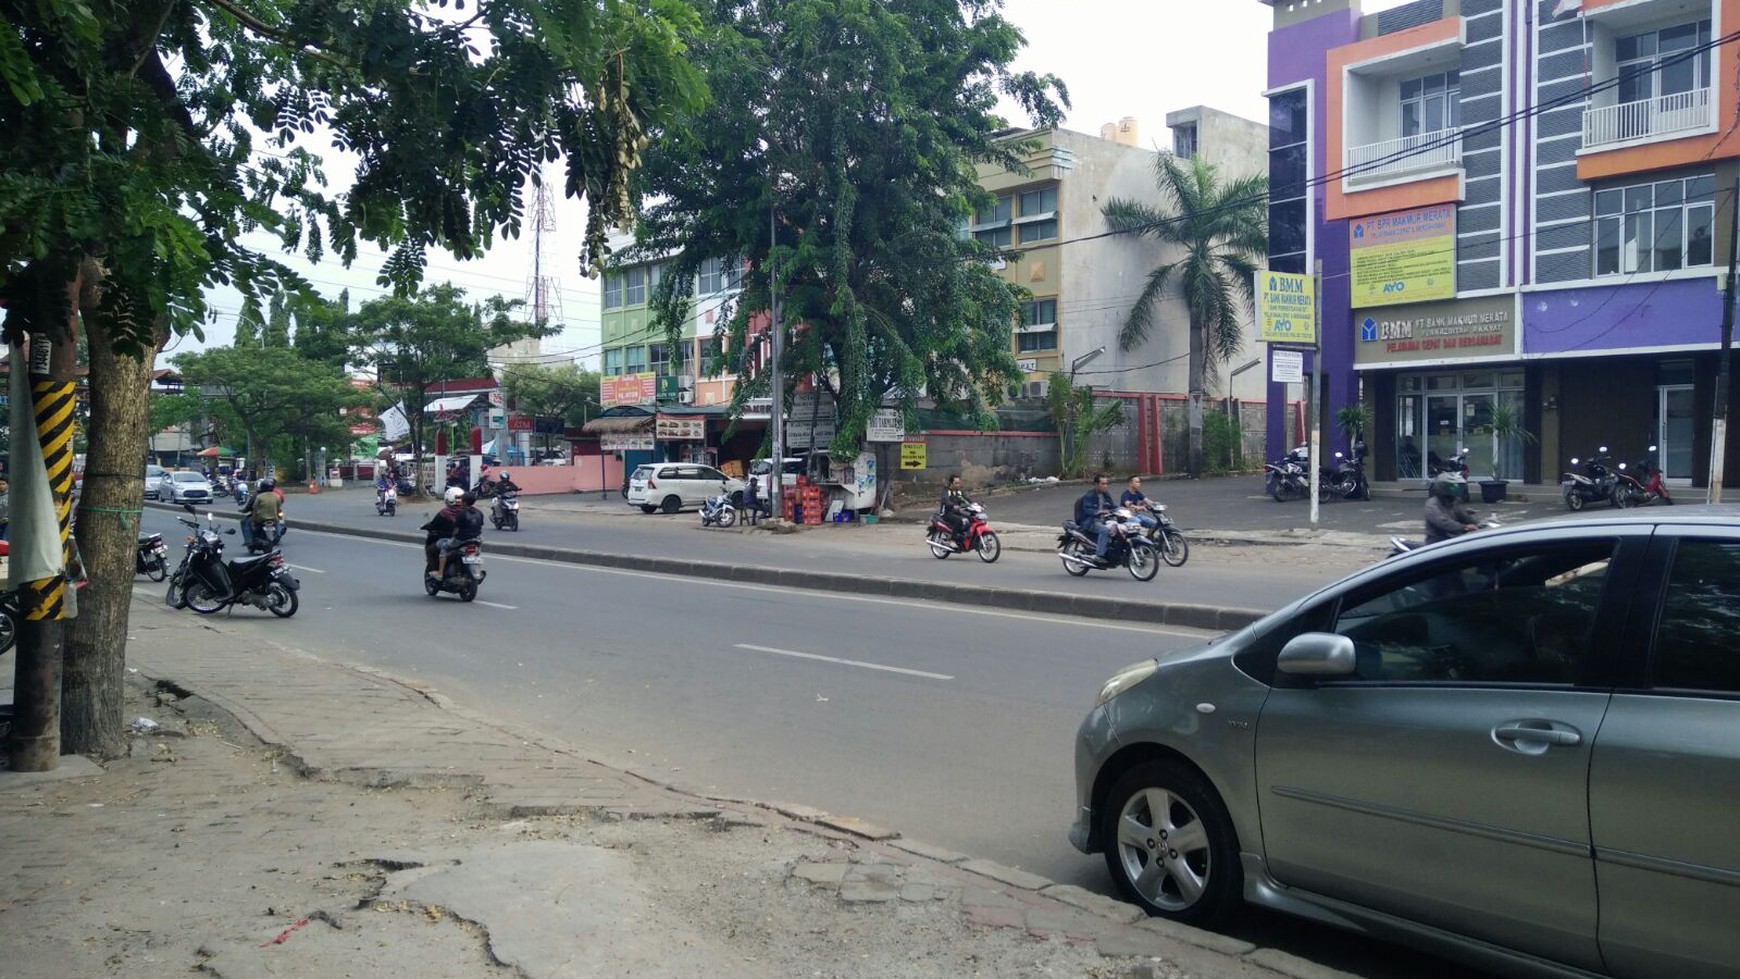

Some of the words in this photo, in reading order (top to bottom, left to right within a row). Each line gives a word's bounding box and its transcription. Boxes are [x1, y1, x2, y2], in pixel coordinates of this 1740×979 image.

[1392, 213, 1421, 226] MAKMUR
[1423, 208, 1451, 221] MERATA
[1279, 277, 1303, 293] BMM
[1383, 281, 1405, 293] AYO
[1274, 318, 1292, 332] AYO
[1380, 320, 1414, 340] BMM
[1426, 317, 1446, 328] BANK
[1448, 314, 1478, 326] MAKMUR
[1480, 311, 1509, 323] MERATA
[513, 420, 531, 429] ATM
